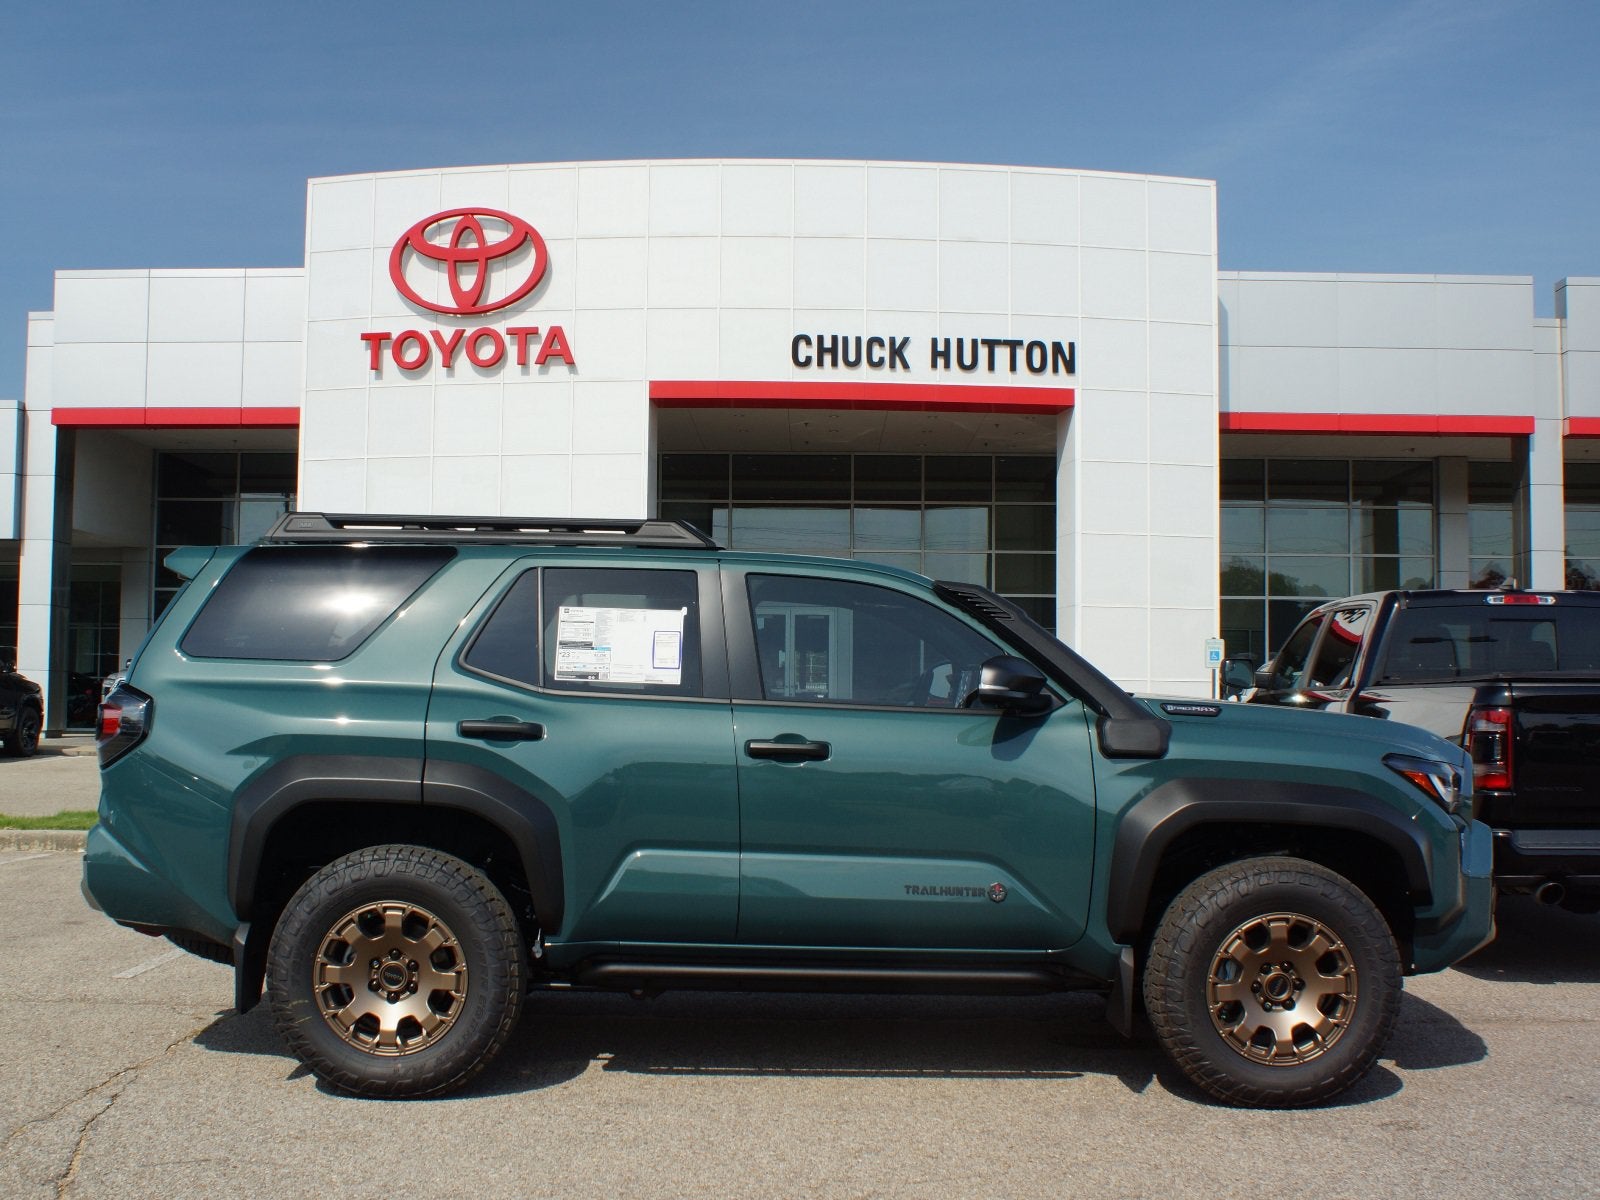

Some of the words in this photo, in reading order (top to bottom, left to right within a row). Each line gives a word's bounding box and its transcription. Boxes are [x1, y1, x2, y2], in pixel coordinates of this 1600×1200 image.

[361, 326, 575, 370] TOYOTA
[791, 334, 911, 369] CHUCK
[931, 337, 1076, 374] HUTTON
[904, 885, 986, 897] TRAILHUNTER
